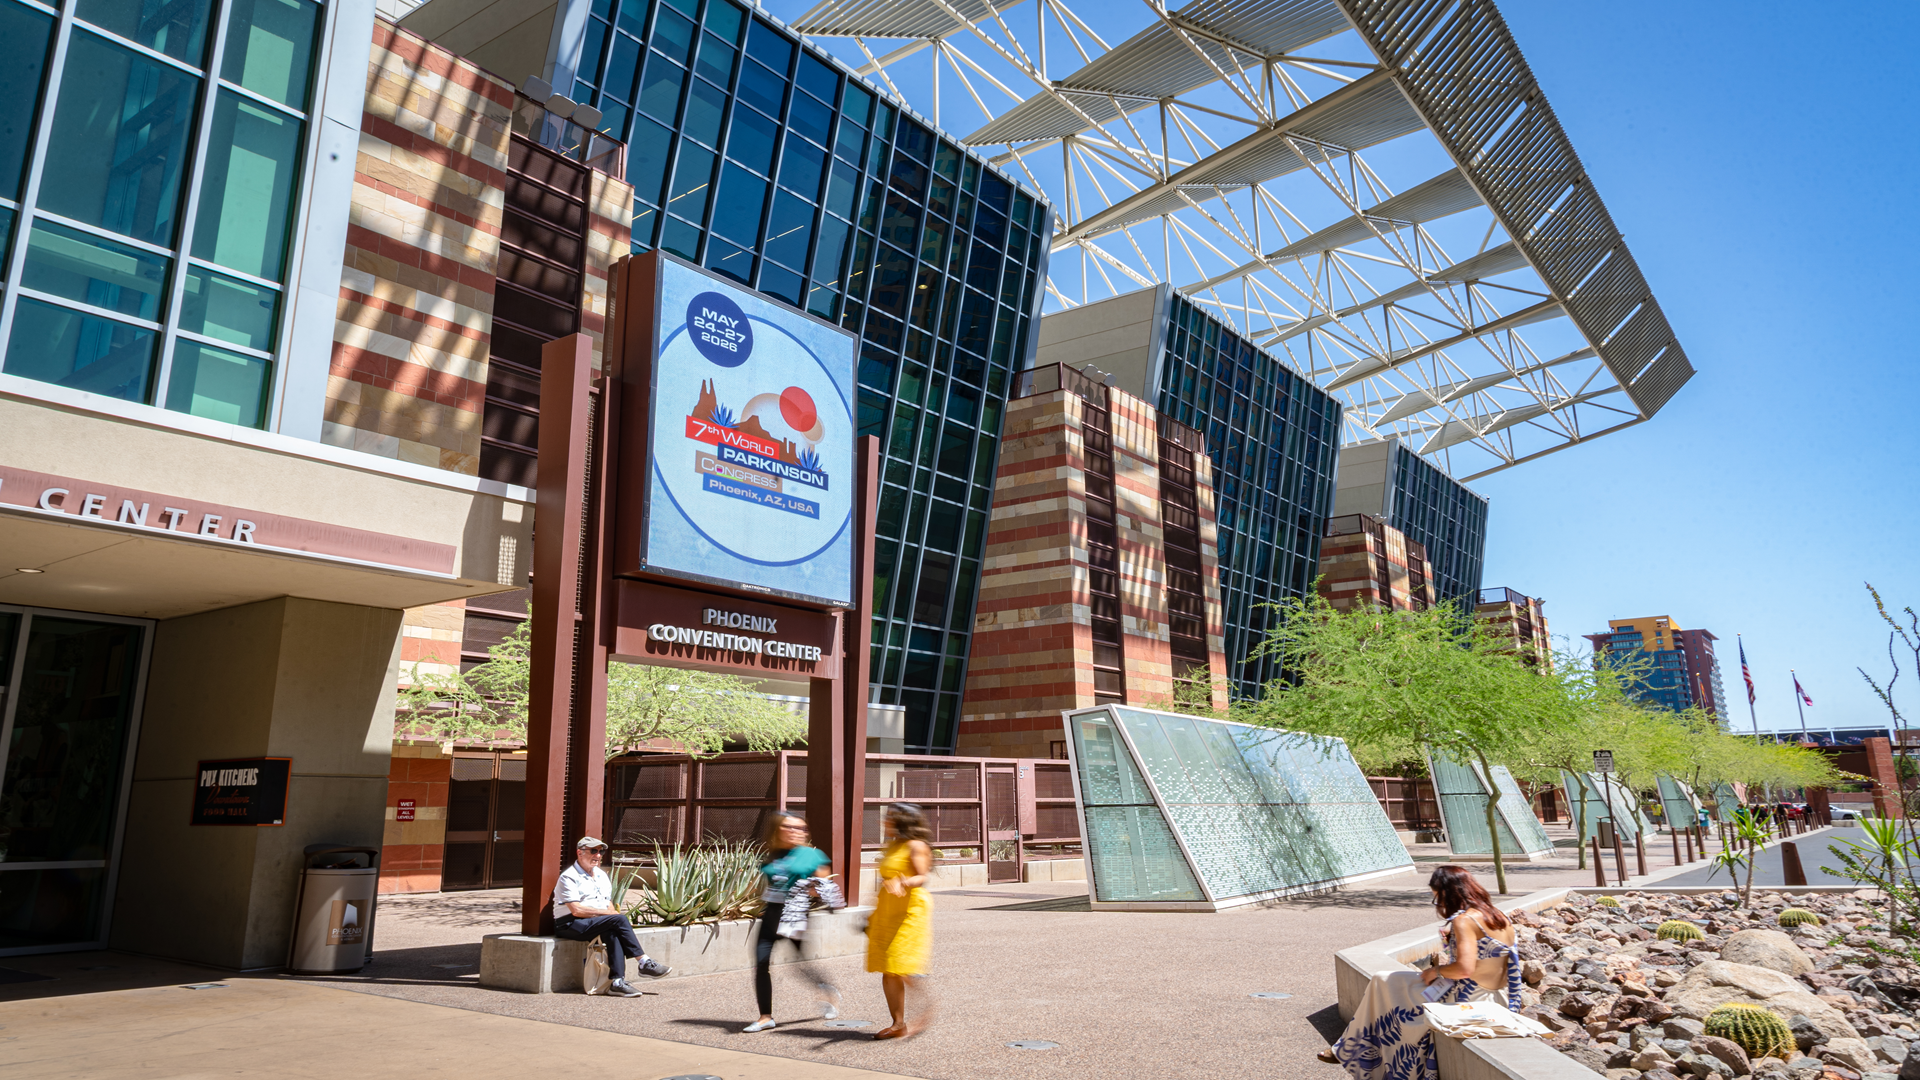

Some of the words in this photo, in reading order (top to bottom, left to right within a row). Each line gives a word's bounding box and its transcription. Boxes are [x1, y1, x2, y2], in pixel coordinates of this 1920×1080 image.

[694, 316, 746, 344] 24-27
[702, 307, 739, 328] MAY
[701, 332, 738, 353] 2026
[692, 420, 720, 437] 7th
[721, 429, 775, 457] WORLD
[701, 457, 778, 489] CONGRESS
[723, 447, 824, 487] PARKINSON
[709, 479, 762, 502] Phoenix,
[764, 494, 786, 509] AZ,
[788, 499, 815, 515] USA
[40, 487, 257, 544] CENTER
[703, 608, 777, 634] PHOENIX
[648, 623, 762, 654] CONVENTION
[764, 640, 822, 662] CENTER
[200, 770, 218, 787] PHX
[218, 767, 259, 787] KITCHENS
[1019, 770, 1024, 779] 3
[203, 808, 225, 816] FOOD
[227, 807, 247, 816] HALL
[332, 926, 363, 935] PHOENIX
